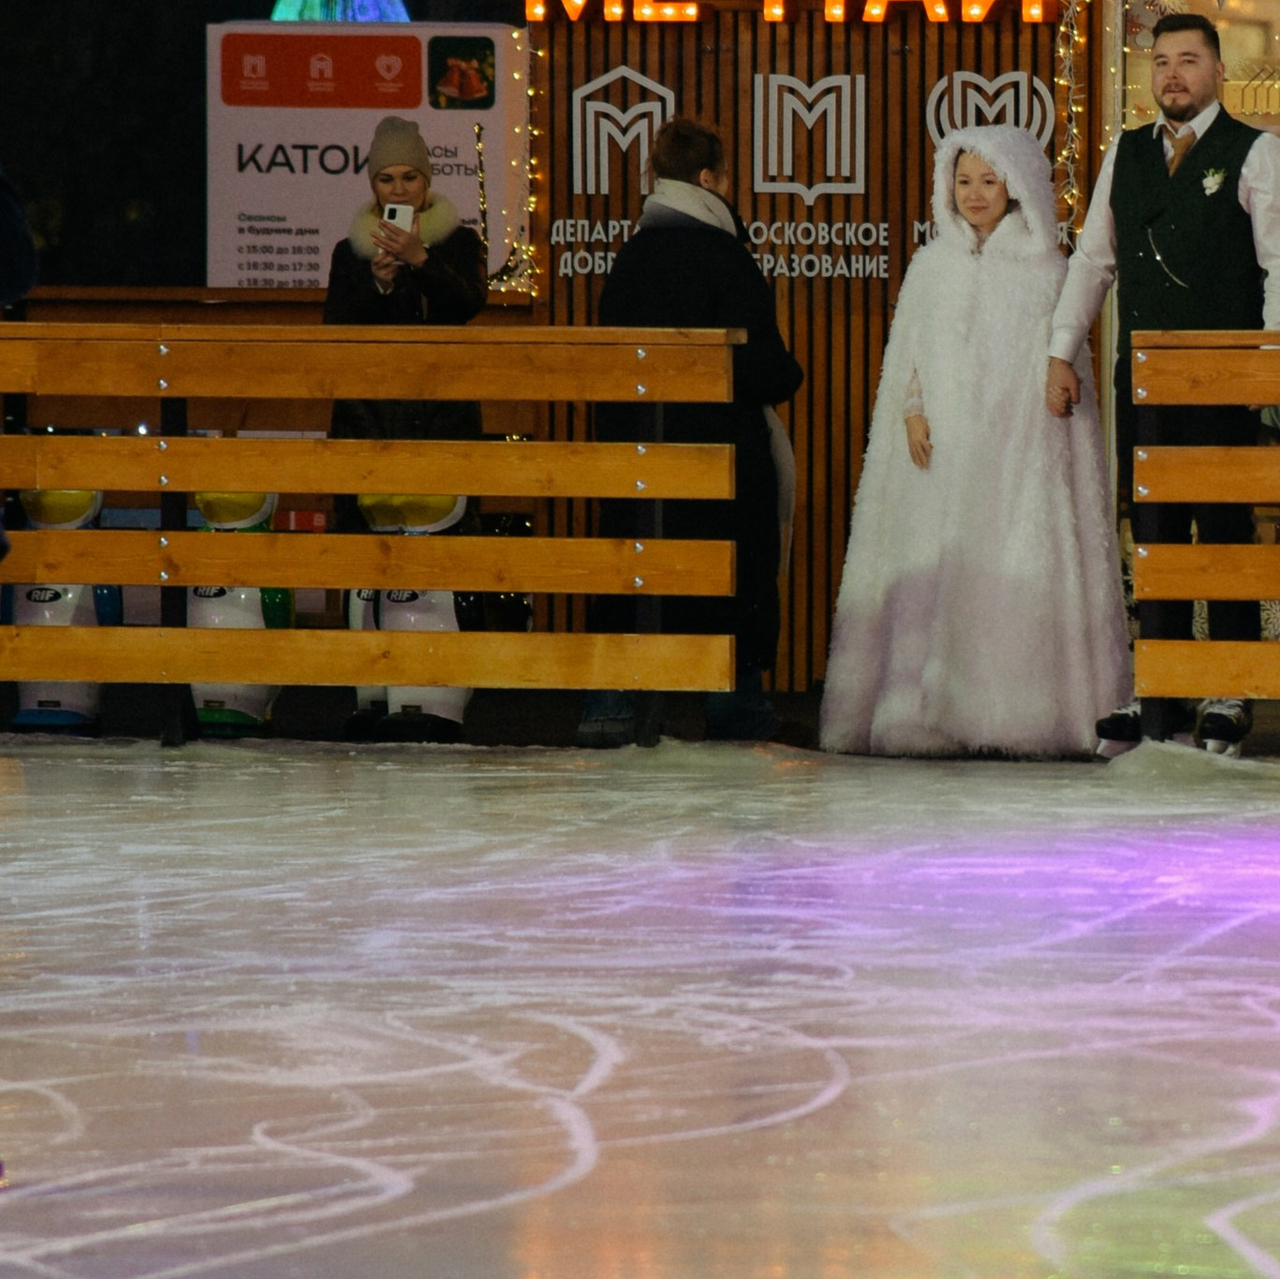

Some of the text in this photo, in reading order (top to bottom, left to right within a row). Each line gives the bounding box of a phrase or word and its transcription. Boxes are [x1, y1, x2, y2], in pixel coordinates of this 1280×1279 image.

[551, 220, 640, 245] ДЕПАРТ
[744, 222, 889, 246] ОСКОВСКОЕ
[31, 590, 55, 601] RIF
[197, 587, 220, 596] RIF
[390, 590, 412, 601] RIF
